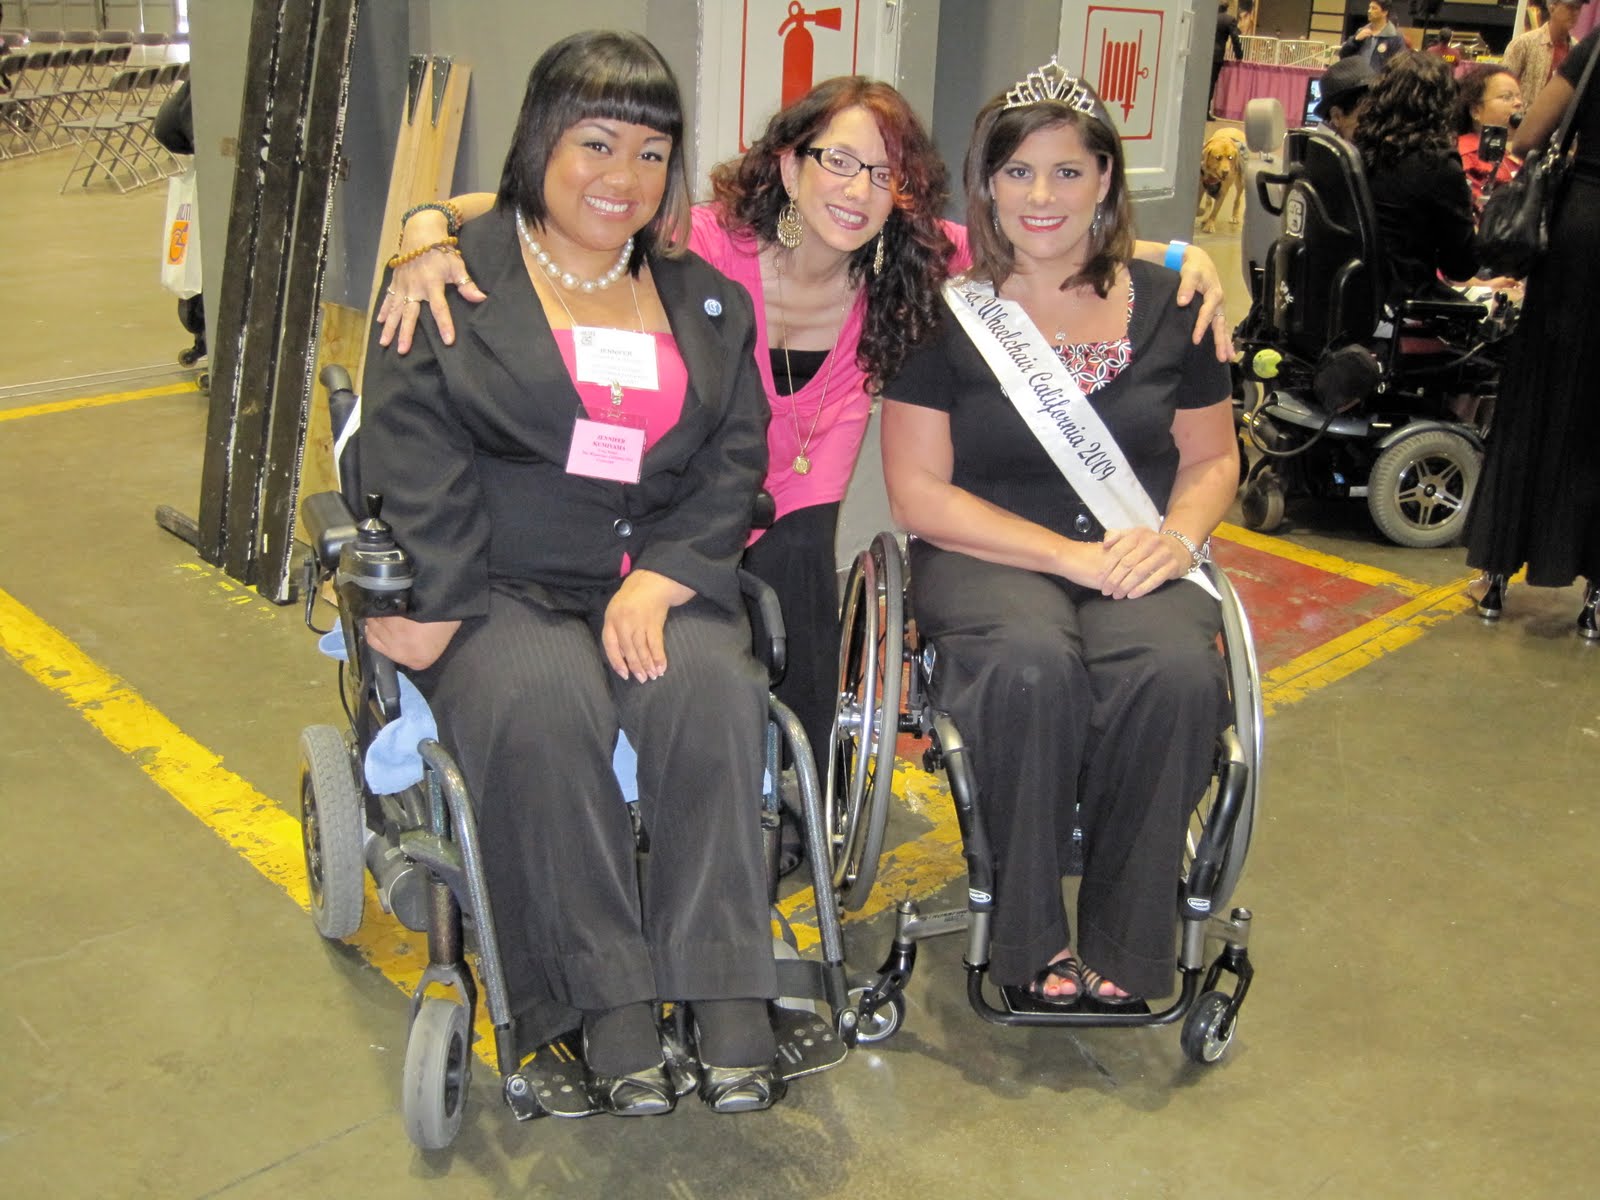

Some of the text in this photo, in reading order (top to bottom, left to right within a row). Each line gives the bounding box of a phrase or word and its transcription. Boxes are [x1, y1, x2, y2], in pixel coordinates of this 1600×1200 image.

[600, 347, 632, 357] JENNIFER
[977, 297, 1033, 374] Wheelchair
[1028, 371, 1085, 449] California
[1078, 442, 1117, 482] 2009
[597, 434, 626, 444] JENNIFER
